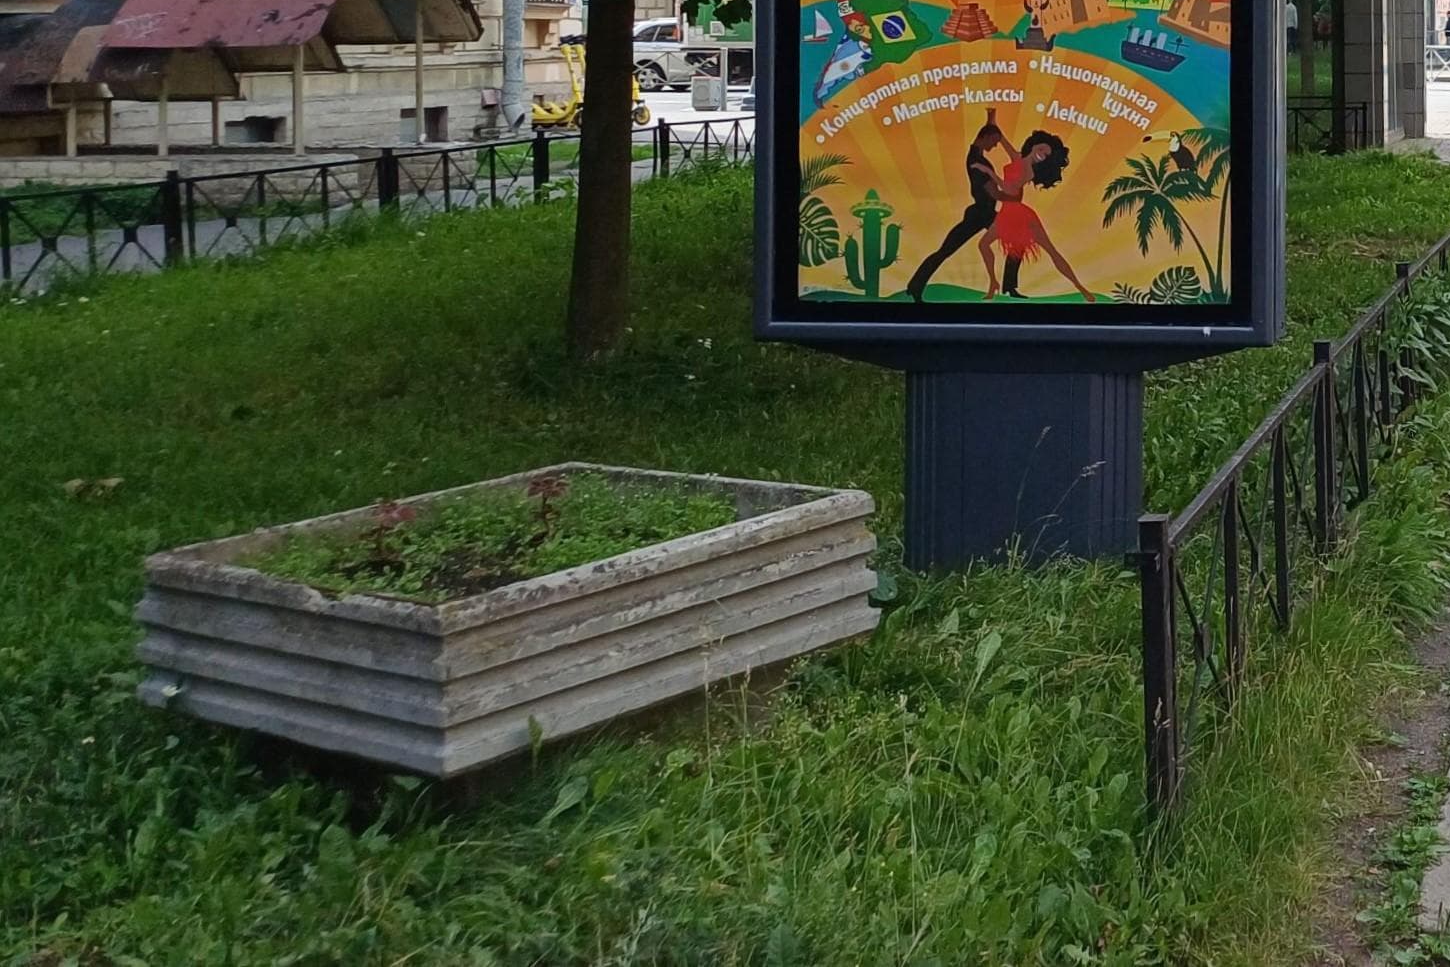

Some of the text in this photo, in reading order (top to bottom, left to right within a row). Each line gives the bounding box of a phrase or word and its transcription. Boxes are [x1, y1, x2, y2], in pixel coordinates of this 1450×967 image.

[820, 60, 1018, 137] Концертная программа
[1040, 55, 1158, 114] Национальная
[892, 87, 1024, 124] Мастер-классы
[1047, 100, 1109, 135] Лекции
[1102, 92, 1151, 131] кухня
